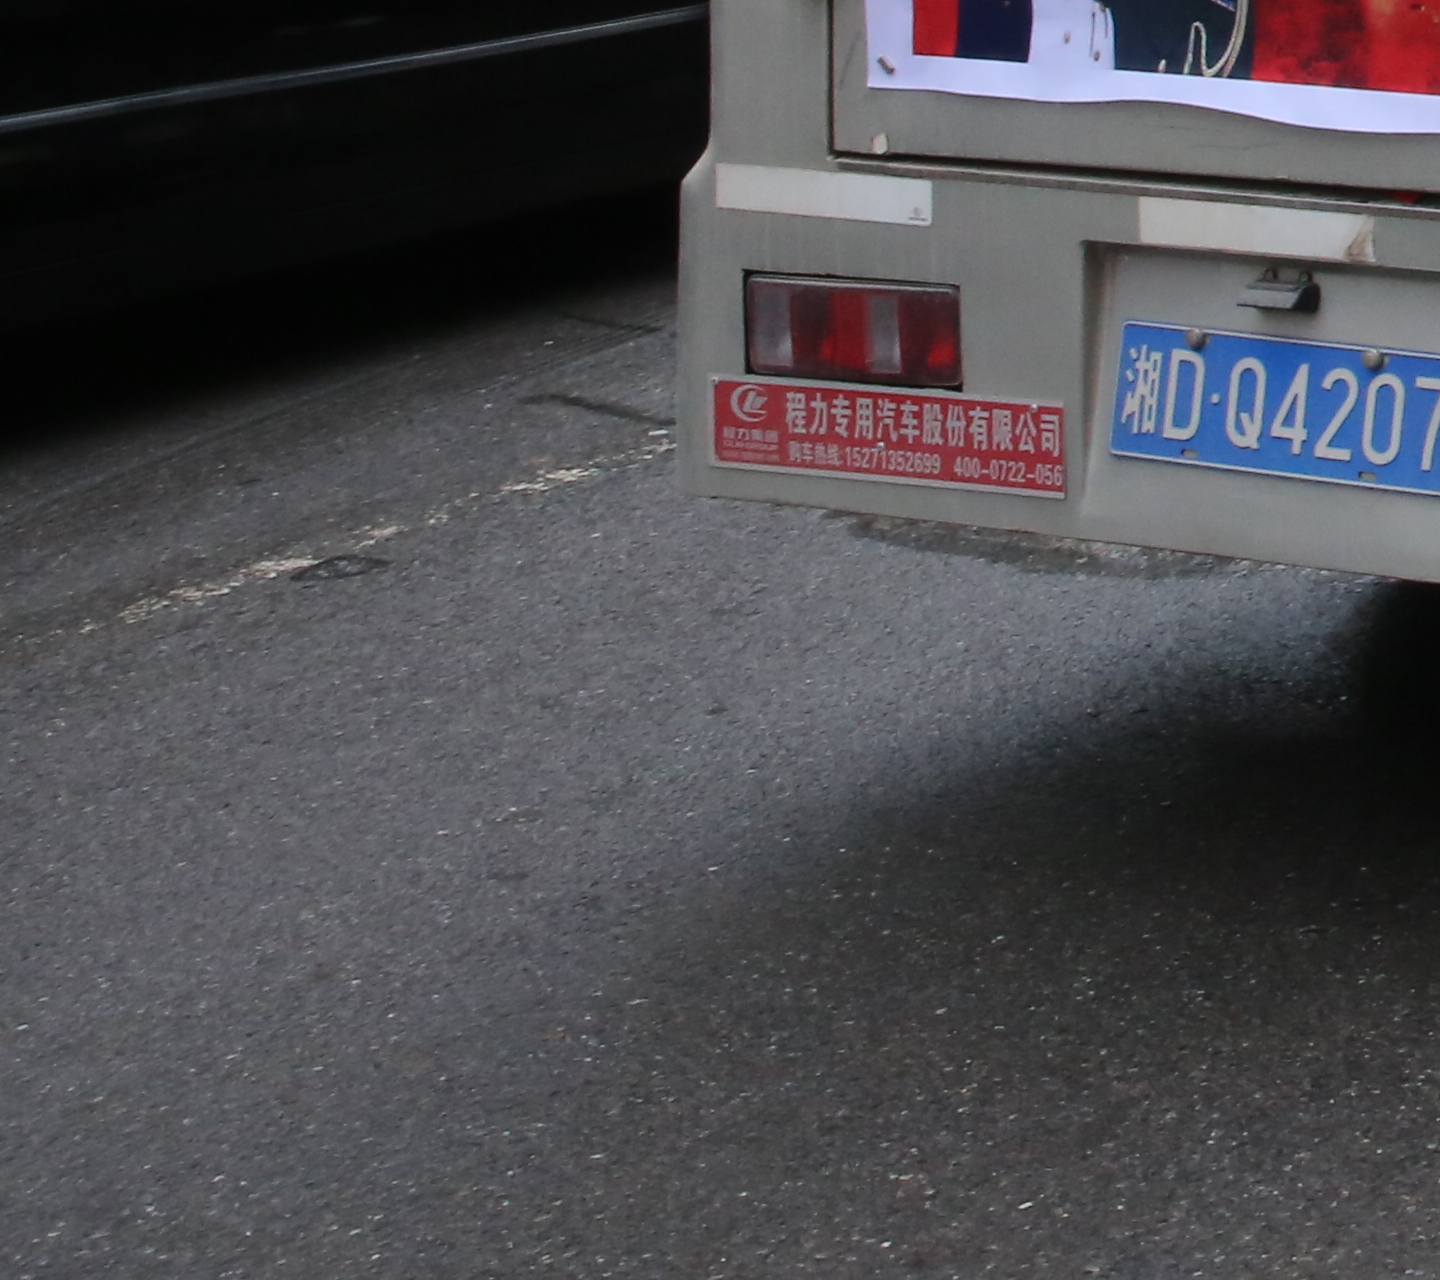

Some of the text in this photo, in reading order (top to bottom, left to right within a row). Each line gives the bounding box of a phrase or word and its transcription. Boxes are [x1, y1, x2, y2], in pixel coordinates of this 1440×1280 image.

[785, 391, 1063, 459] 程力专用汽车股份有限公司
